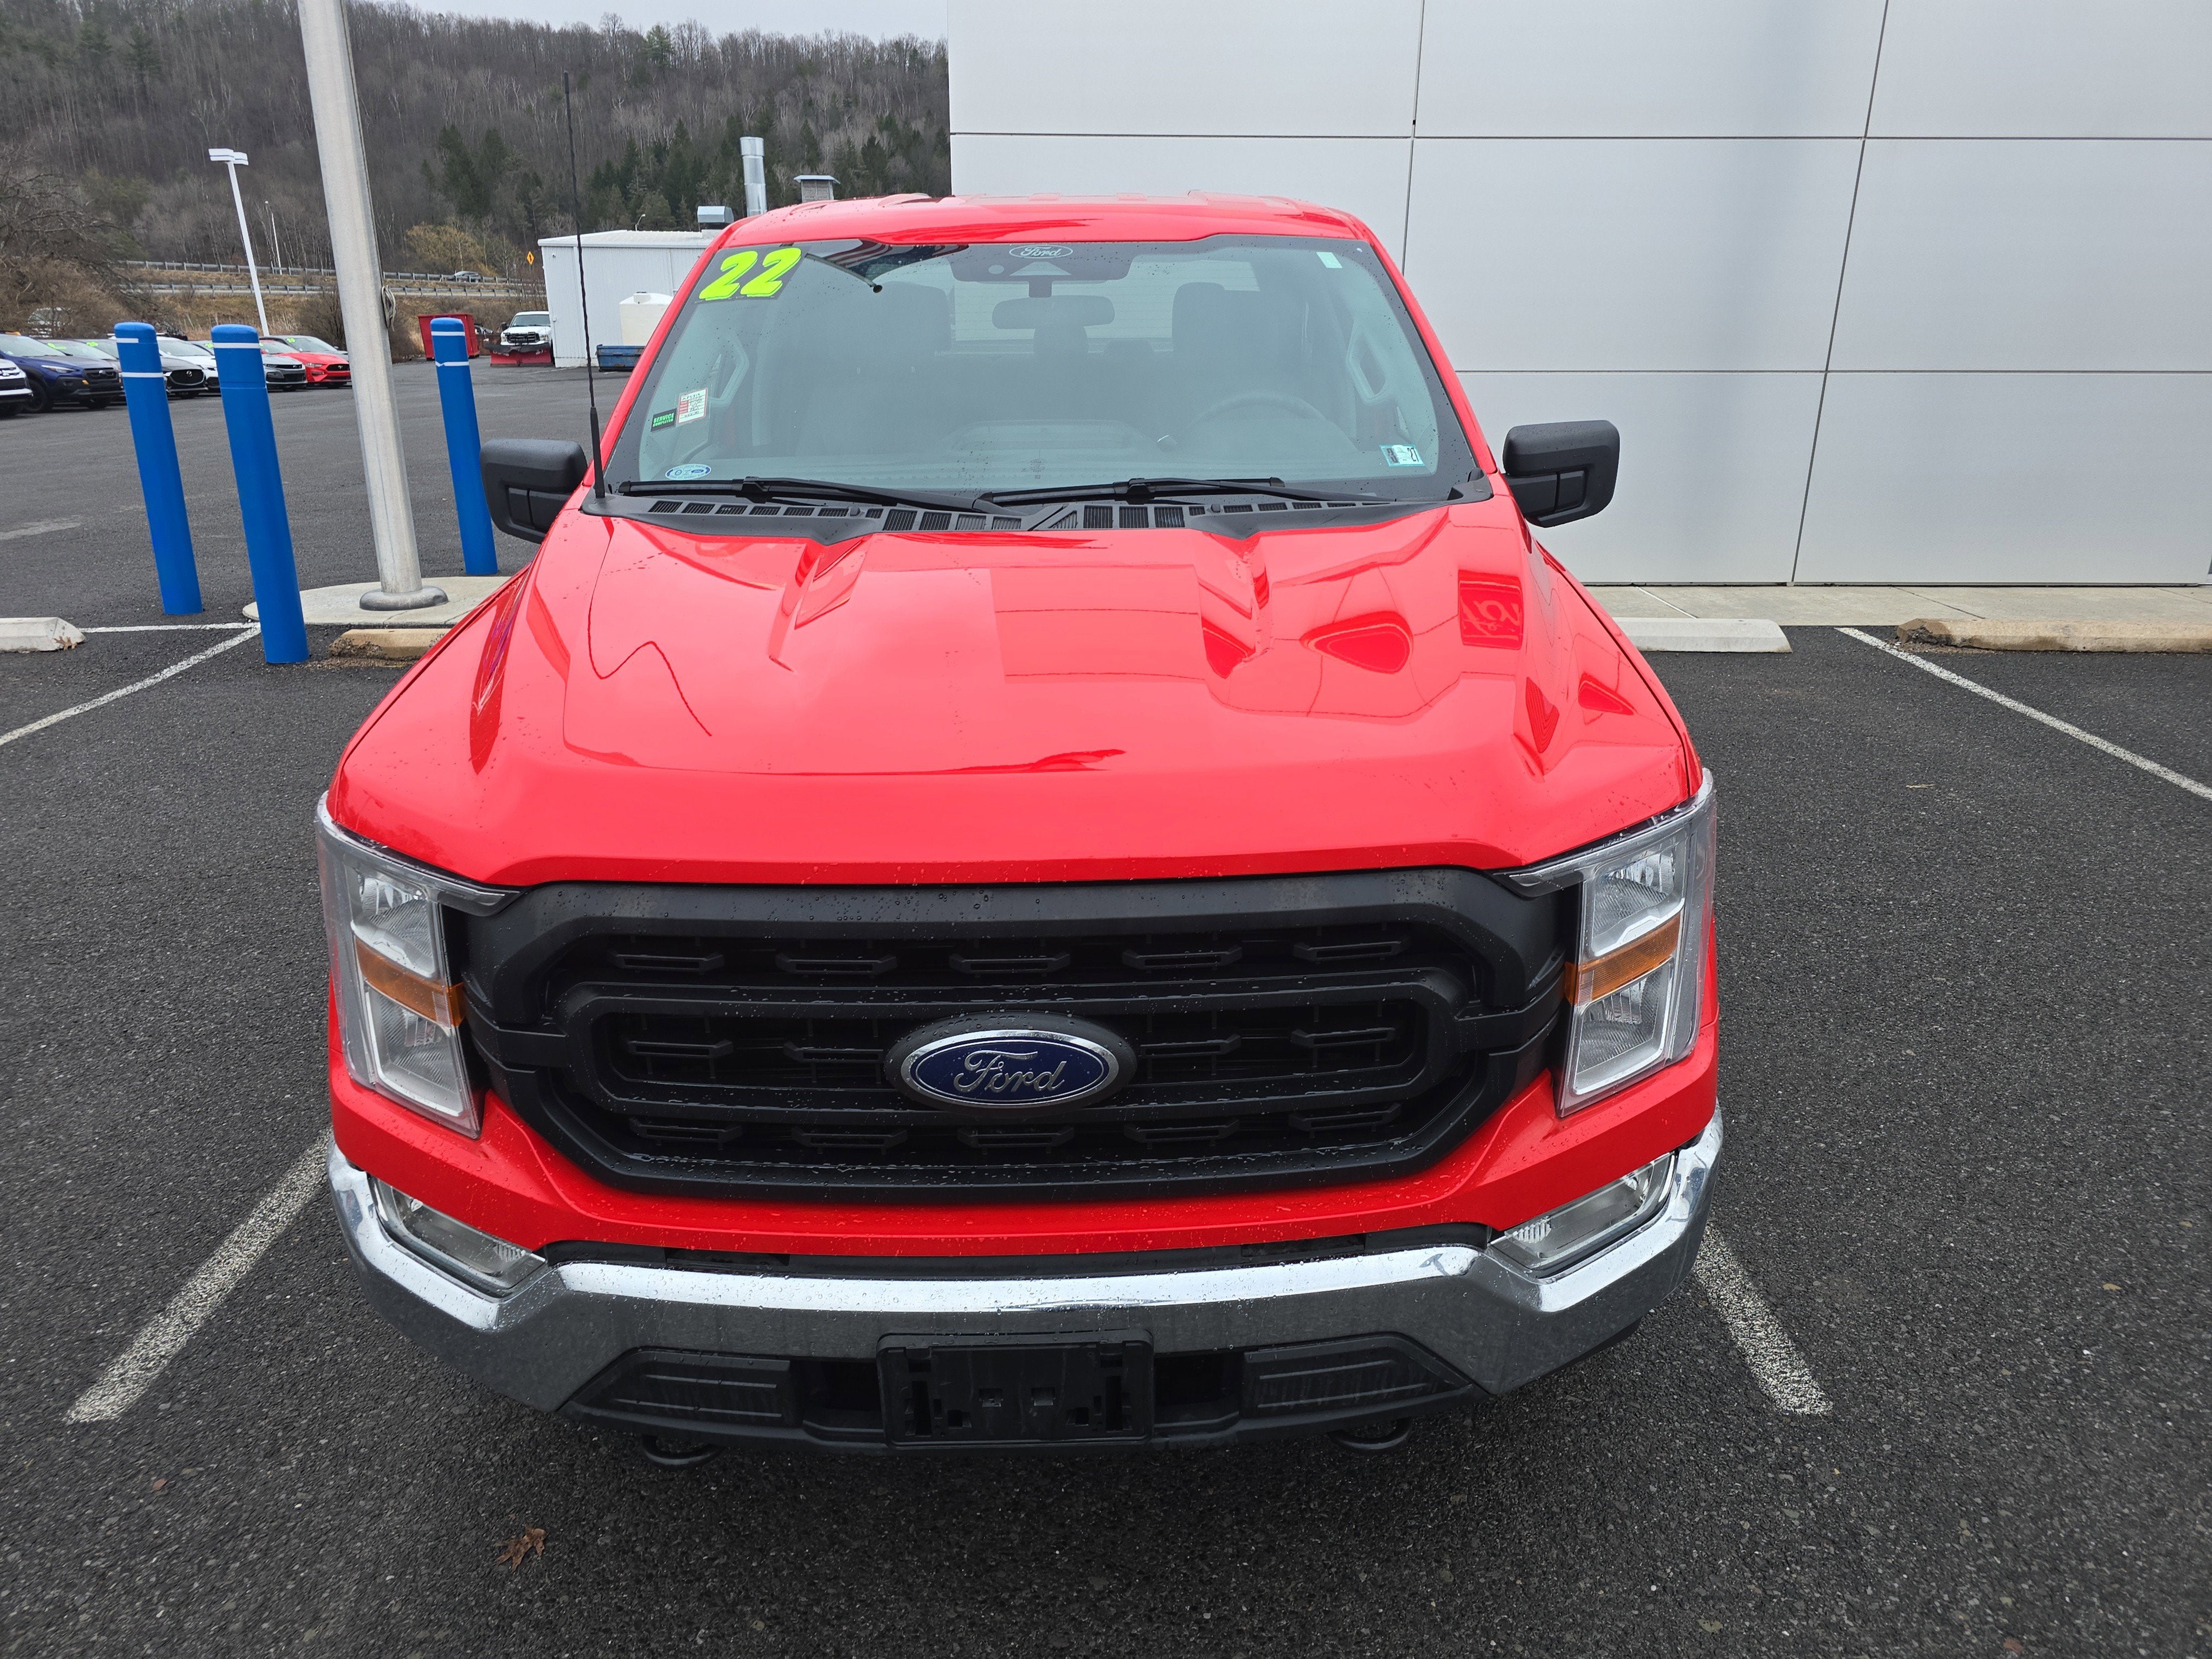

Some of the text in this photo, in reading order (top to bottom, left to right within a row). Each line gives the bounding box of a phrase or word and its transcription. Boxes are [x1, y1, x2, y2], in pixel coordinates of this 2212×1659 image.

[1020, 246, 1062, 256] Ford
[699, 247, 801, 301] 22
[653, 413, 675, 423] SERVICE
[1407, 447, 1419, 462] 27
[953, 1049, 1068, 1094] Ford
